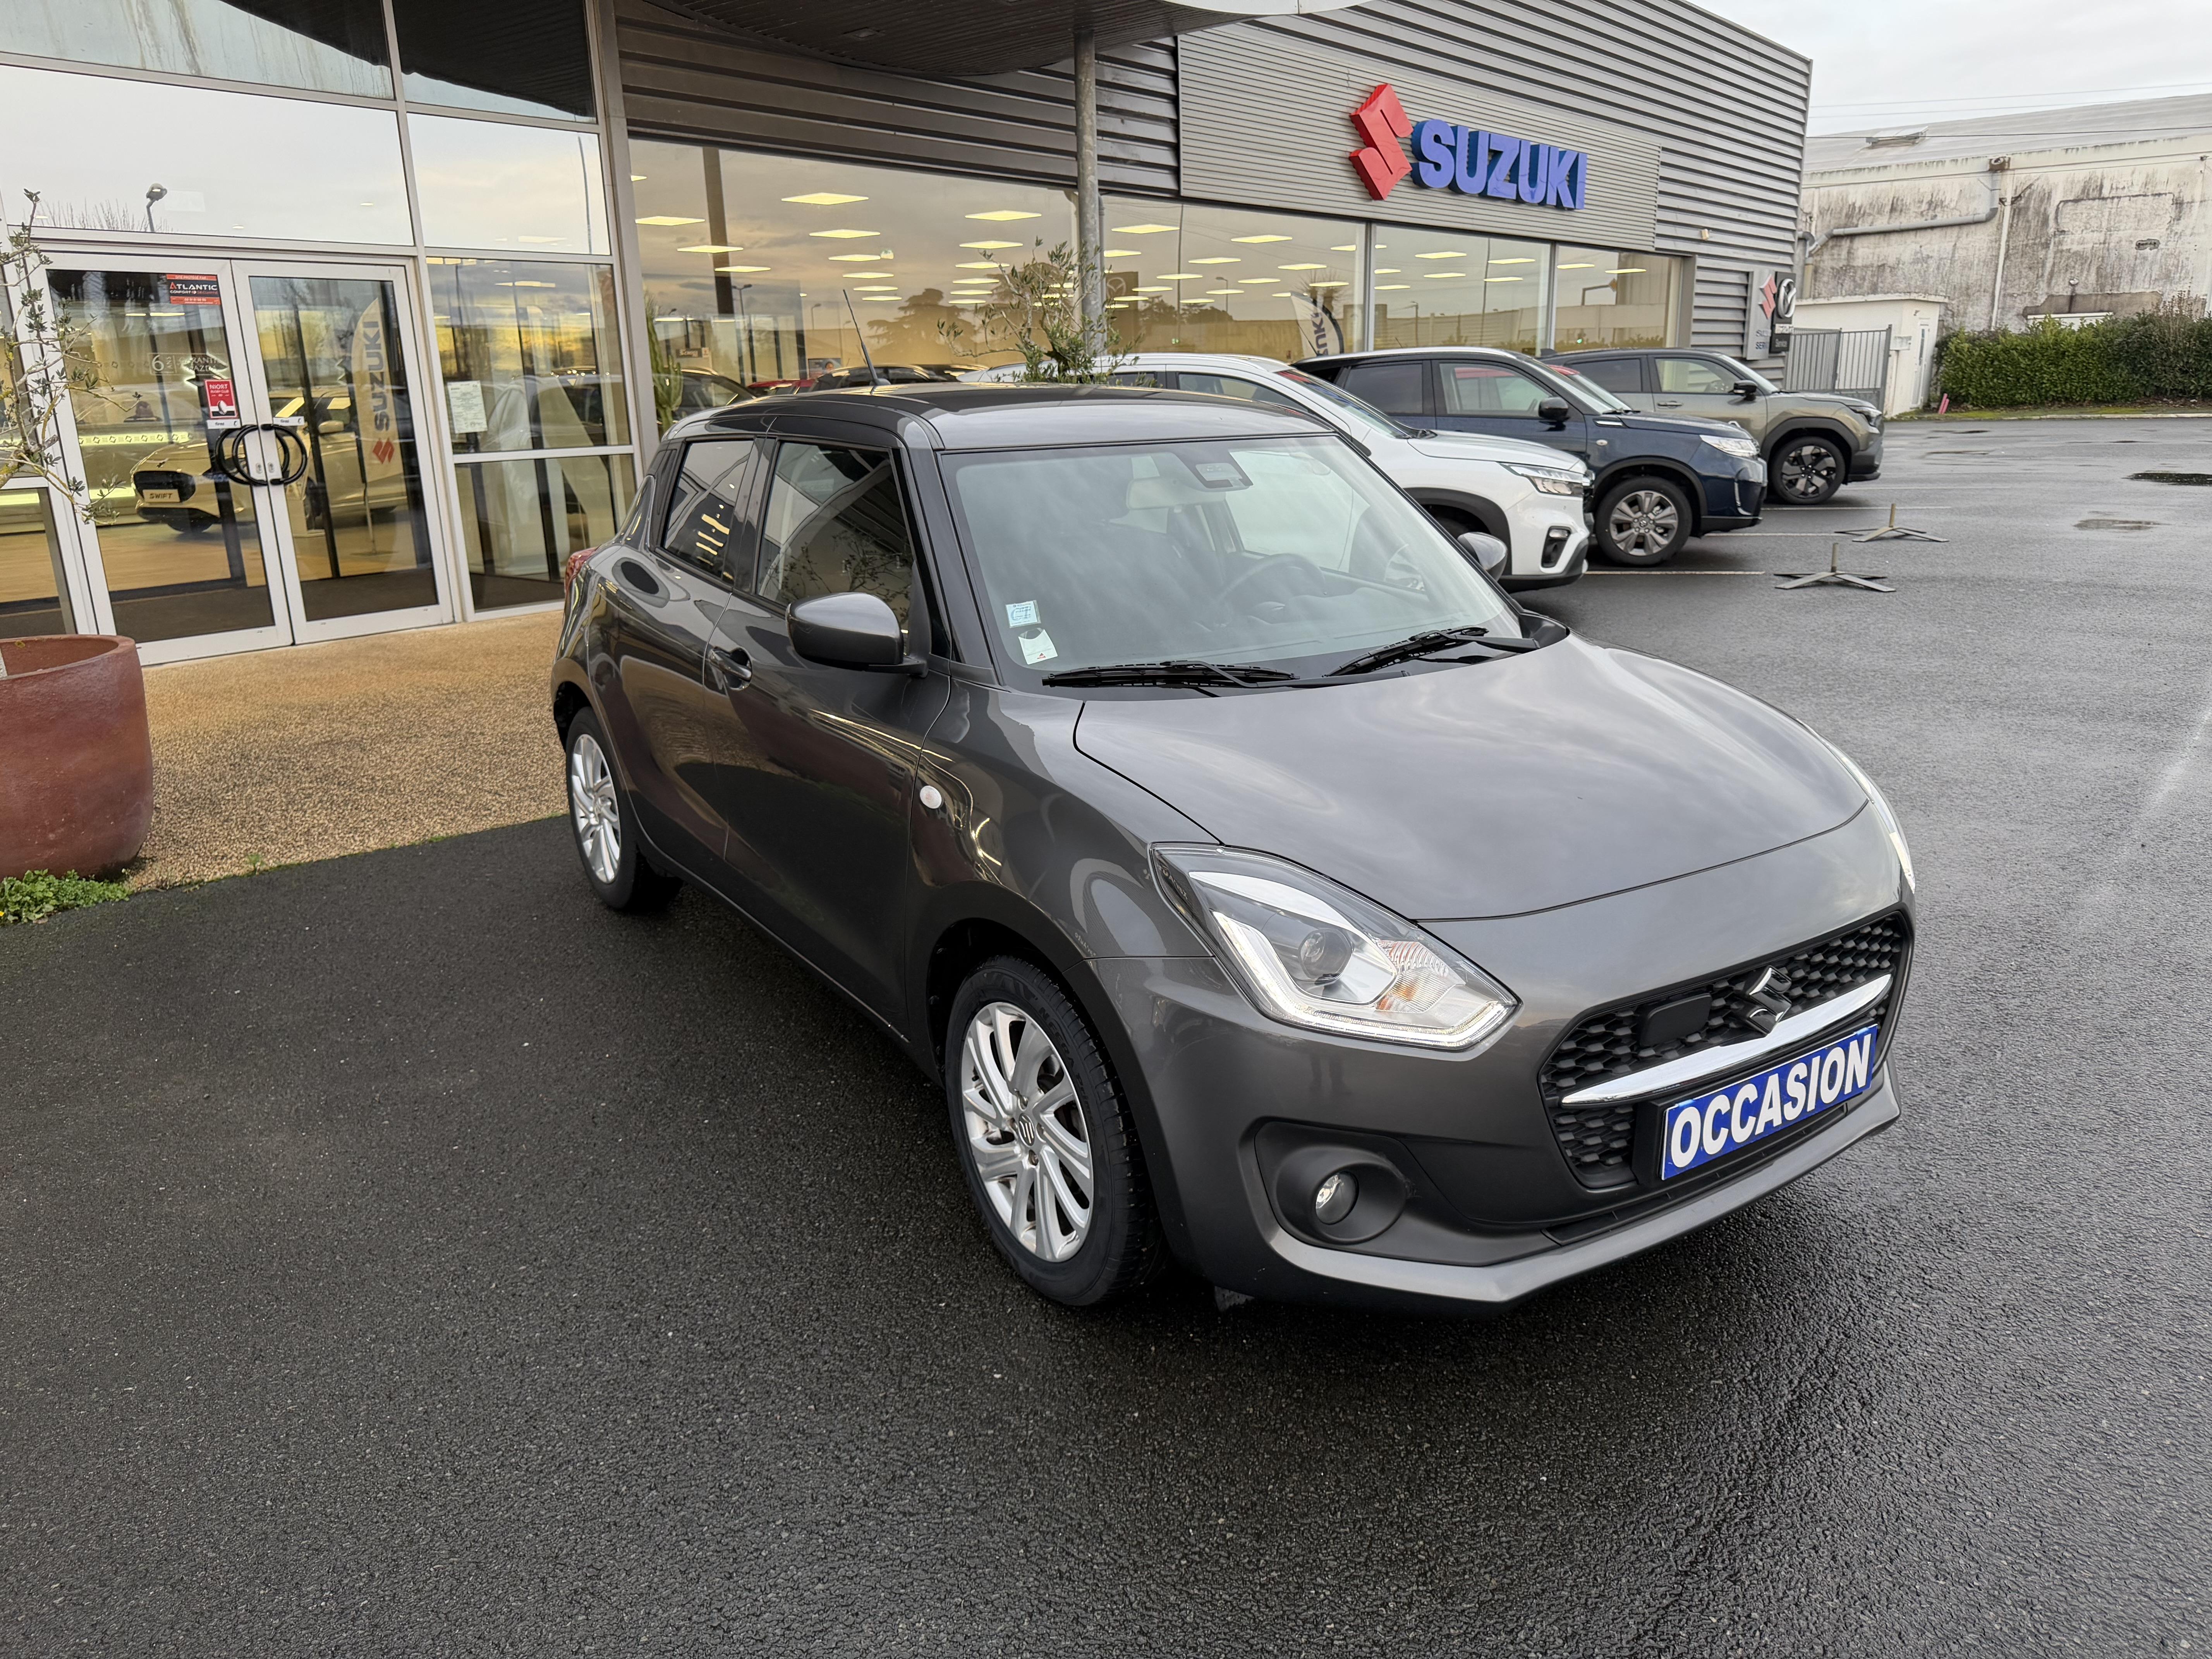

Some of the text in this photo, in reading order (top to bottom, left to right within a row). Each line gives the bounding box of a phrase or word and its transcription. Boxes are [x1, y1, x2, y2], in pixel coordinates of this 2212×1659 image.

[1411, 119, 1587, 210] SUZUKI
[170, 282, 218, 290] ATLANTIC
[152, 355, 164, 371] 6
[363, 321, 390, 432] SUZUKI
[1670, 1033, 1872, 1168] OCCASION
